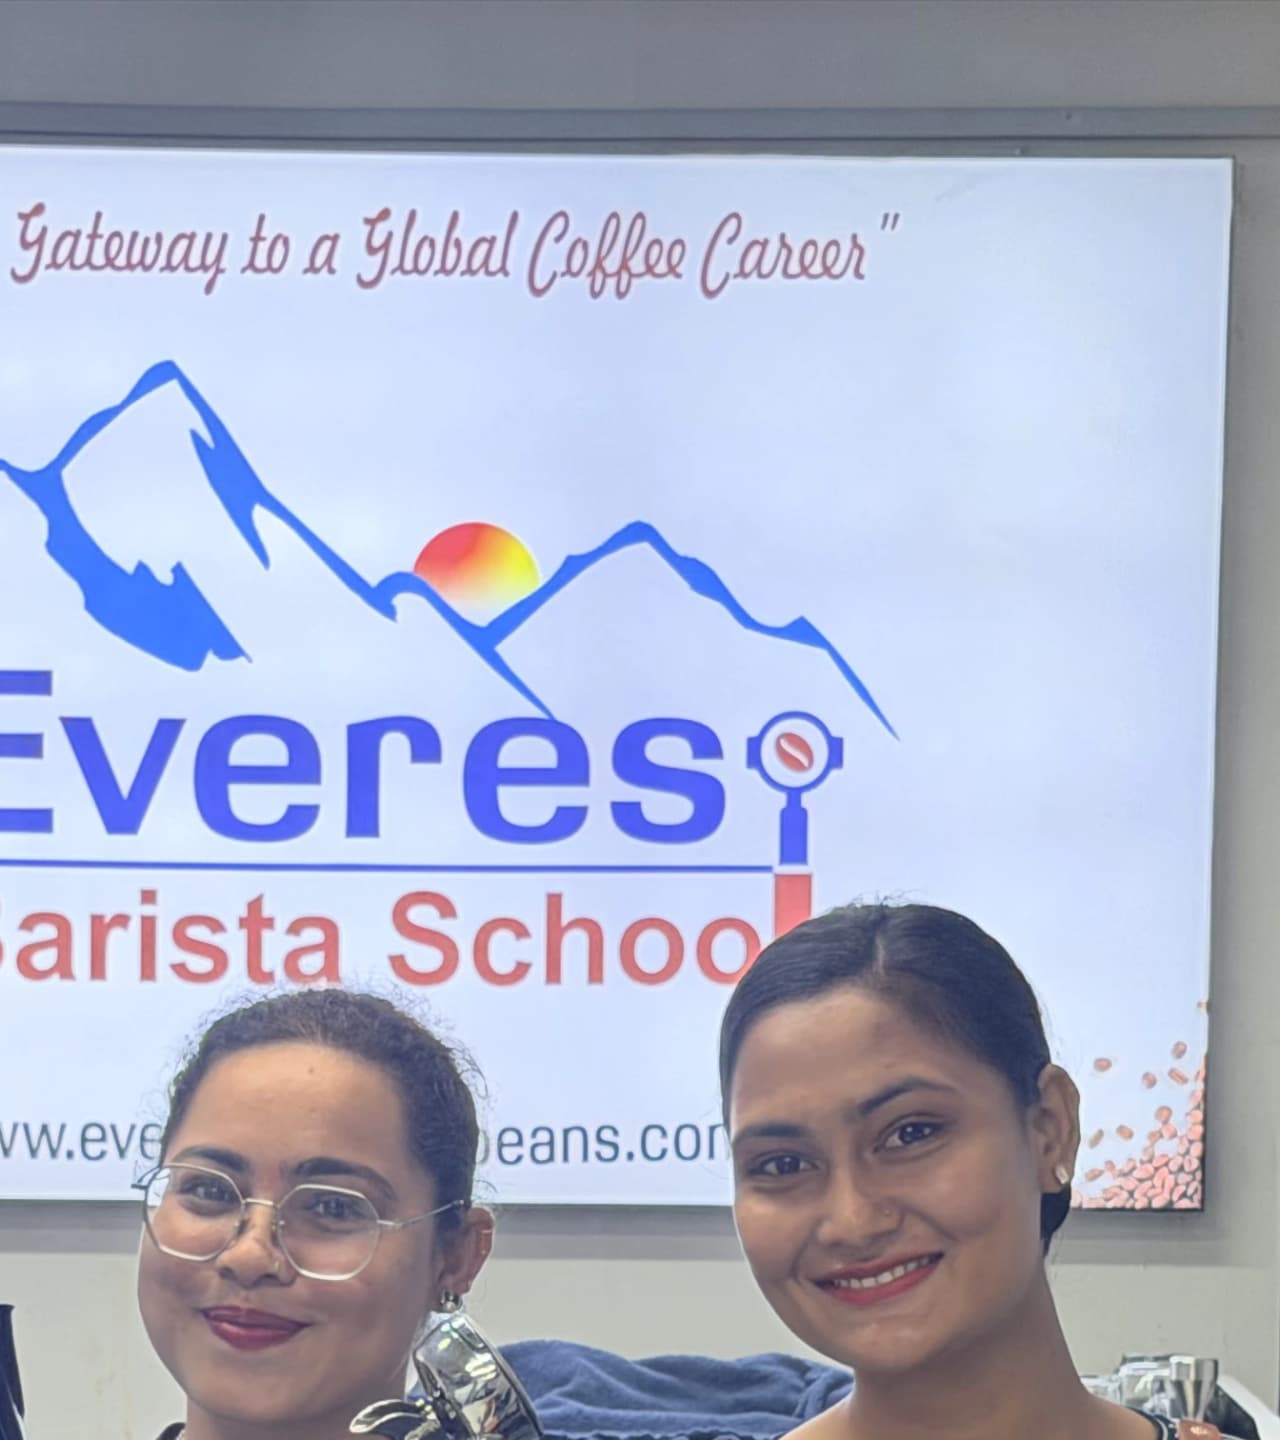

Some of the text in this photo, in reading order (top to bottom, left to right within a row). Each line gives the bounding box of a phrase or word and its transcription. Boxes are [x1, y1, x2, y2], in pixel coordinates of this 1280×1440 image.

[11, 202, 228, 295] Gateway
[240, 213, 290, 275] to
[303, 232, 340, 275] a
[356, 207, 519, 290] Global
[527, 210, 686, 300] Coffee
